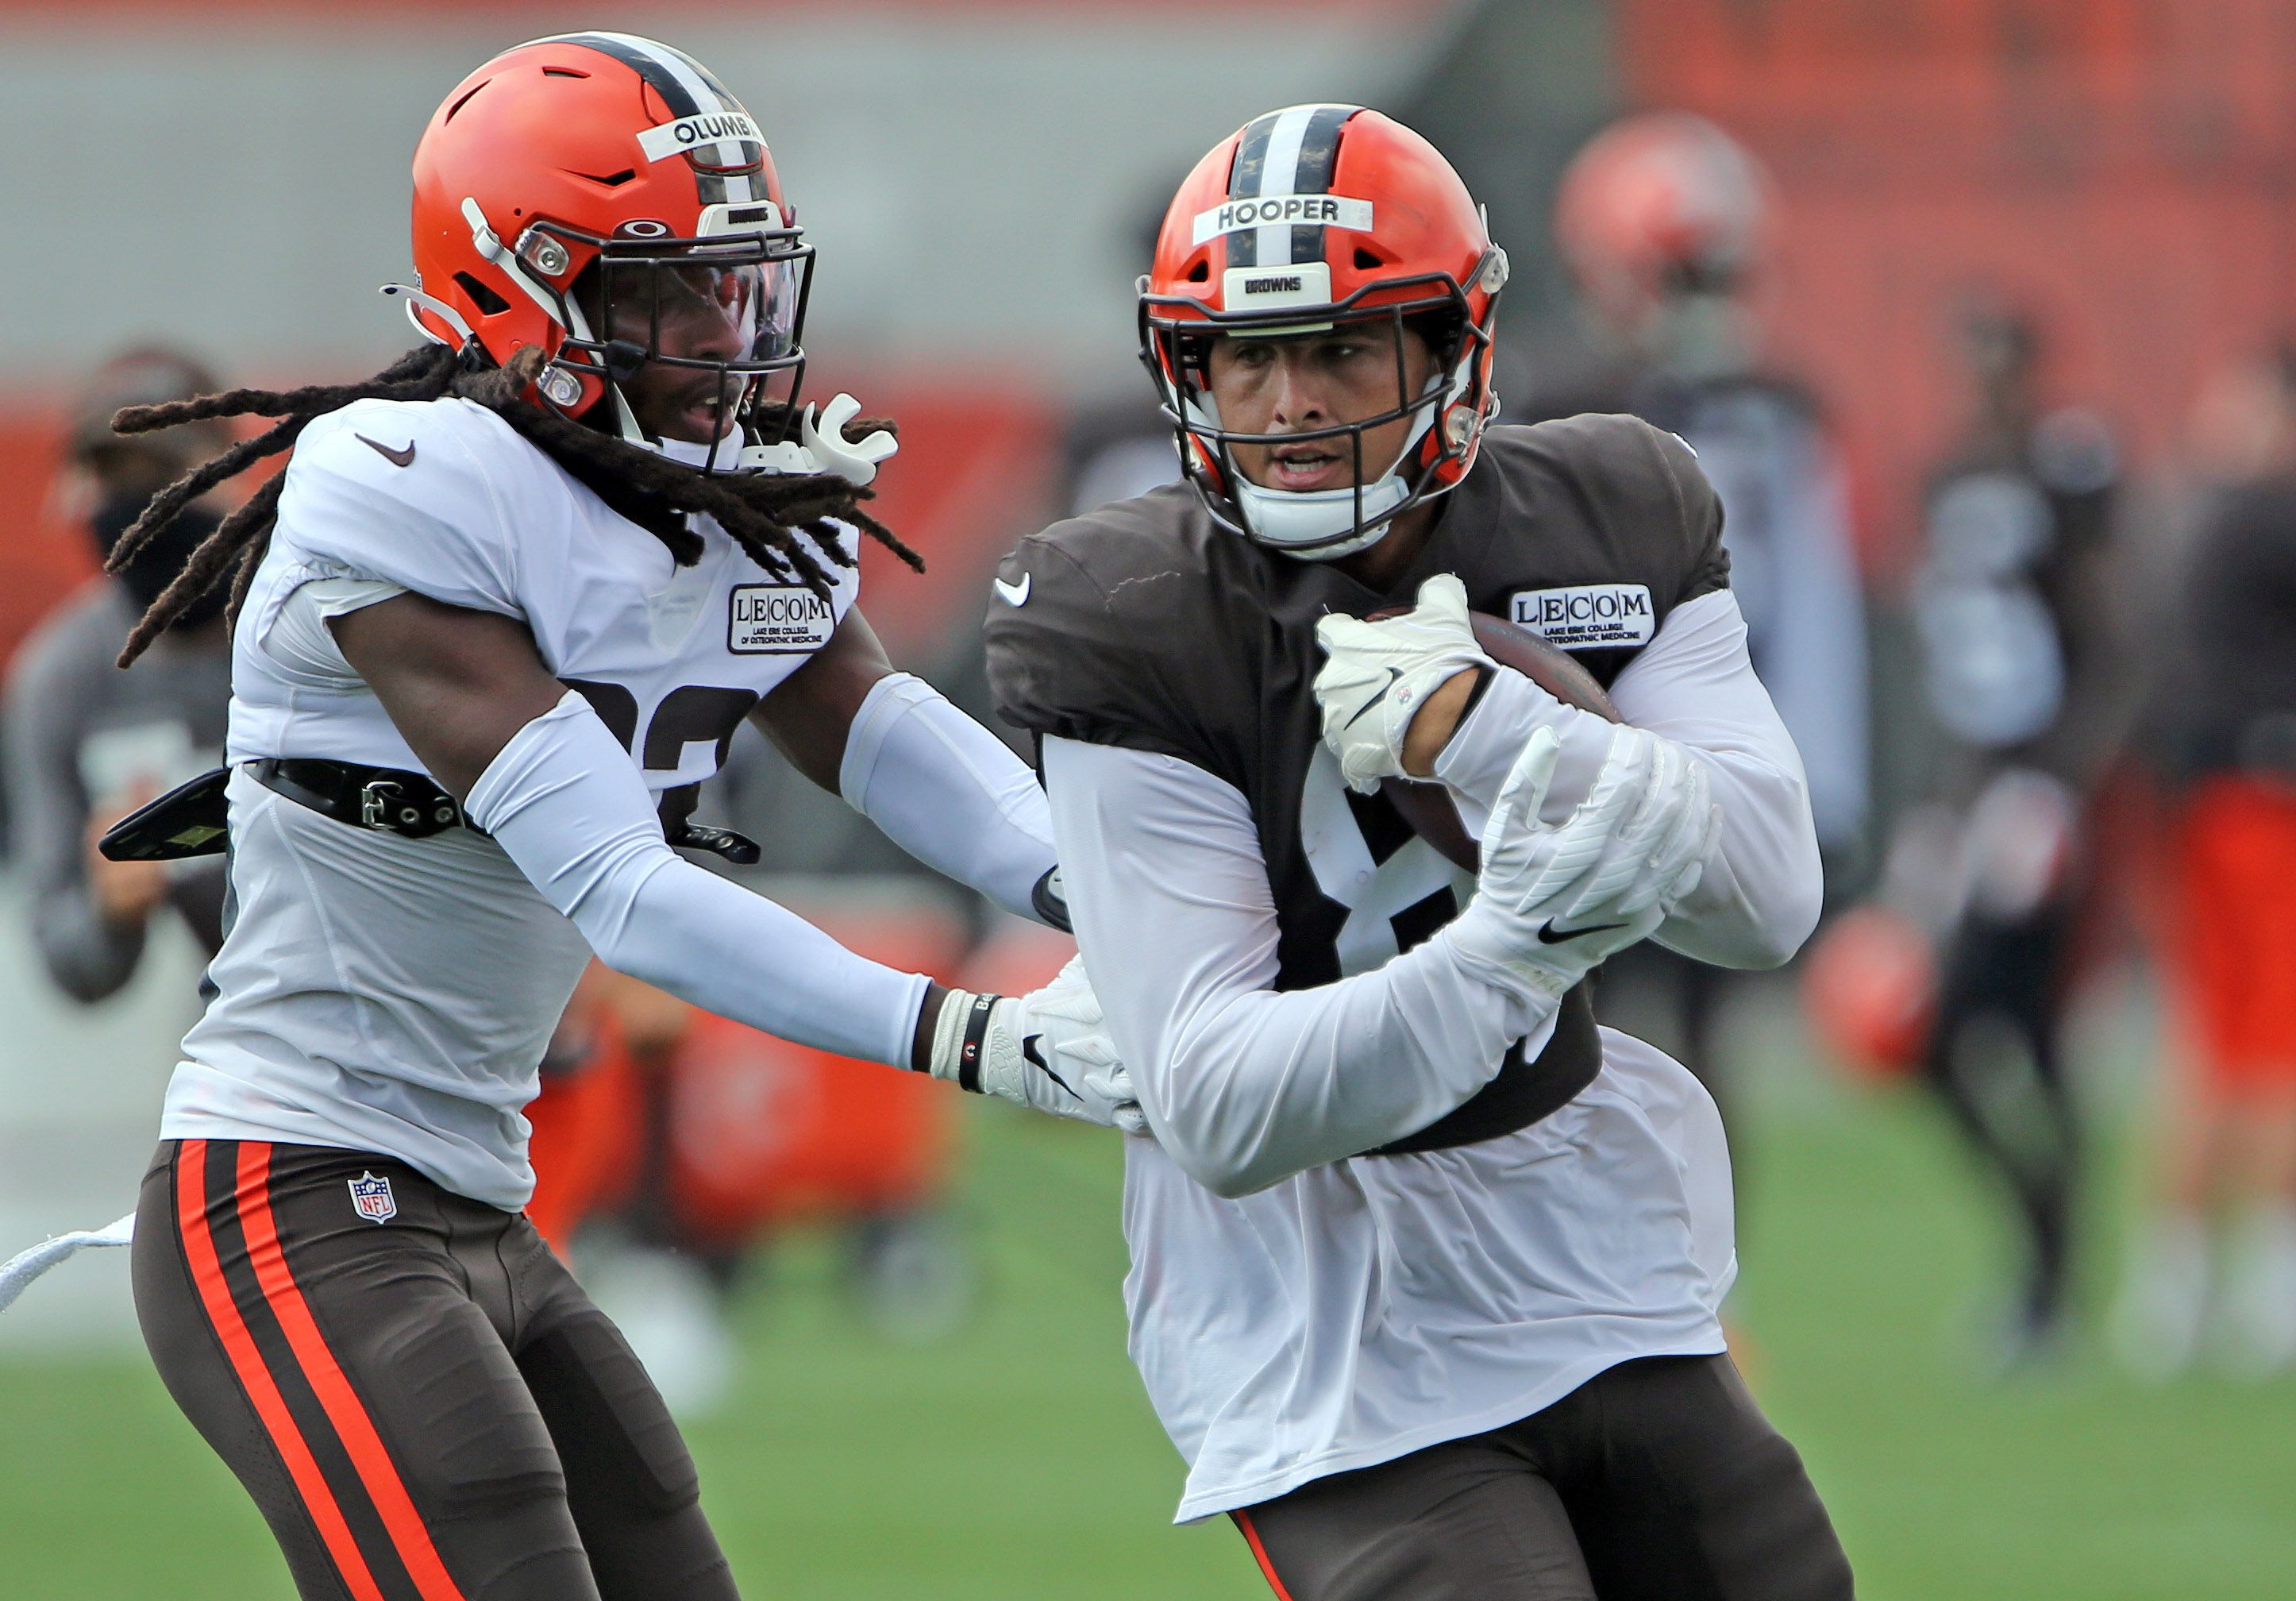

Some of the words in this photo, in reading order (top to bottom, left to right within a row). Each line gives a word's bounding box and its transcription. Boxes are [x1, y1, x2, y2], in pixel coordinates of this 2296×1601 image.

[674, 116, 757, 145] OLUMB
[1218, 199, 1339, 230] HOOPER
[1245, 276, 1301, 295] BROWNS
[1588, 623, 1624, 632] COLLEGE
[1601, 631, 1640, 641] MEDICINE
[360, 1194, 391, 1214] NFL
